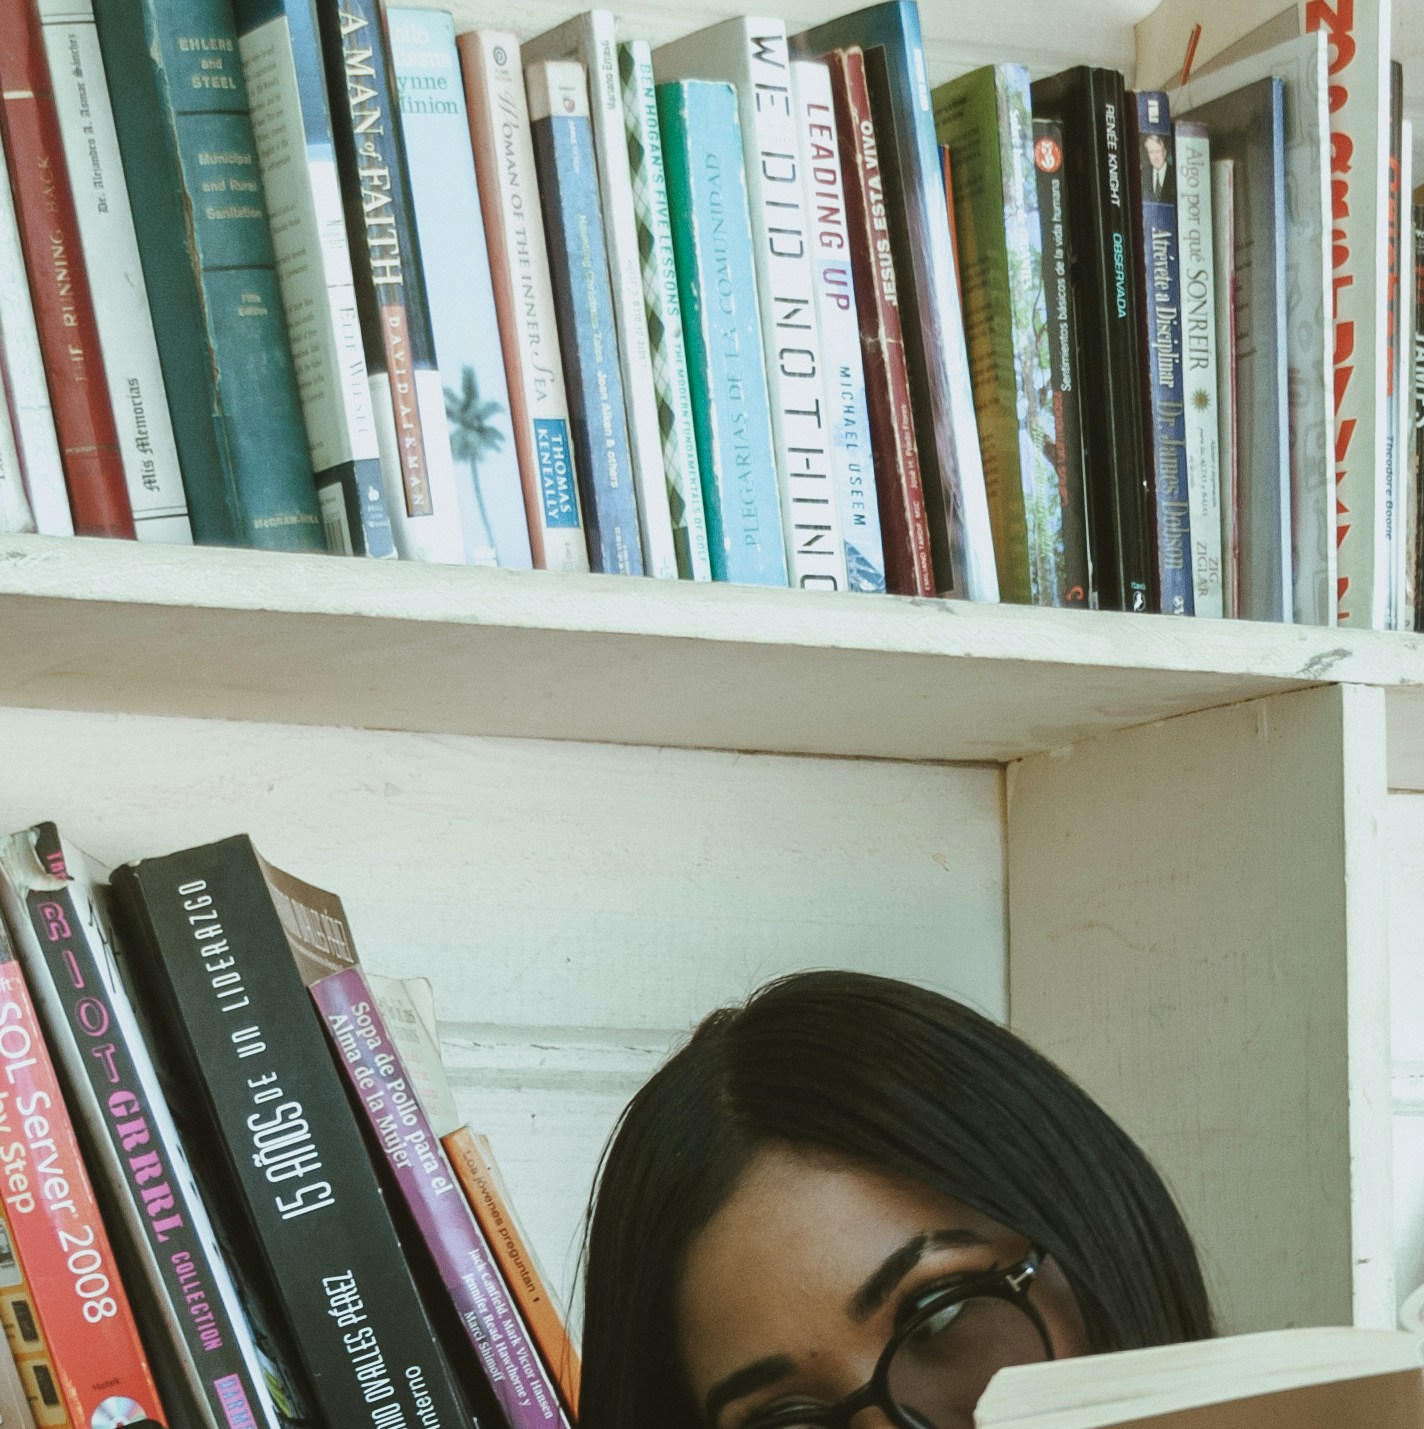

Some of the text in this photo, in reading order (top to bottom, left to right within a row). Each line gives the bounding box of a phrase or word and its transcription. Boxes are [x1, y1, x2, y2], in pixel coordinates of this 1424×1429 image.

[177, 36, 235, 52] EHLERS
[191, 76, 237, 91] STEEL
[201, 58, 223, 70] and
[750, 34, 791, 116] WE
[198, 152, 252, 166] Municipal
[202, 178, 257, 193] and Rural
[340, 12, 405, 287] A MAN of FAITH
[639, 63, 681, 316] BEN HOGAN'S FIVE LESSONS
[760, 150, 805, 260] DID
[1105, 103, 1122, 208] RENÉE KNIGHT
[806, 102, 850, 312] LEADING UP
[860, 120, 899, 308] JESUS ESTA VIVO
[1181, 146, 1210, 372] Algo por qué SONREÍR
[1112, 232, 1128, 319] OBSERVADA
[127, 377, 161, 492] Mis Memorias
[388, 314, 425, 508] DAVID AIKMAN
[839, 365, 867, 527] MICHAEL USEEM
[253, 513, 320, 530] McGRAW-HILL
[537, 427, 561, 520] KENEALLY
[550, 432, 572, 514] THOMAS
[177, 878, 337, 1221] 15 AÑOS DE UN LIDERAZGO
[328, 1013, 414, 1172] Alma de la Mujer
[350, 1000, 456, 1197] Sopa de Pollo para el
[38, 901, 121, 1084] RIOT
[107, 1090, 185, 1244] GRRRL
[170, 1251, 223, 1351] COLLECTION
[16, 1090, 78, 1214] Server
[58, 1224, 119, 1324] 2008
[463, 1149, 537, 1295] Los jóvenes preguntan
[321, 1269, 368, 1328] PÉREZ
[343, 1325, 396, 1403] OVALLES
